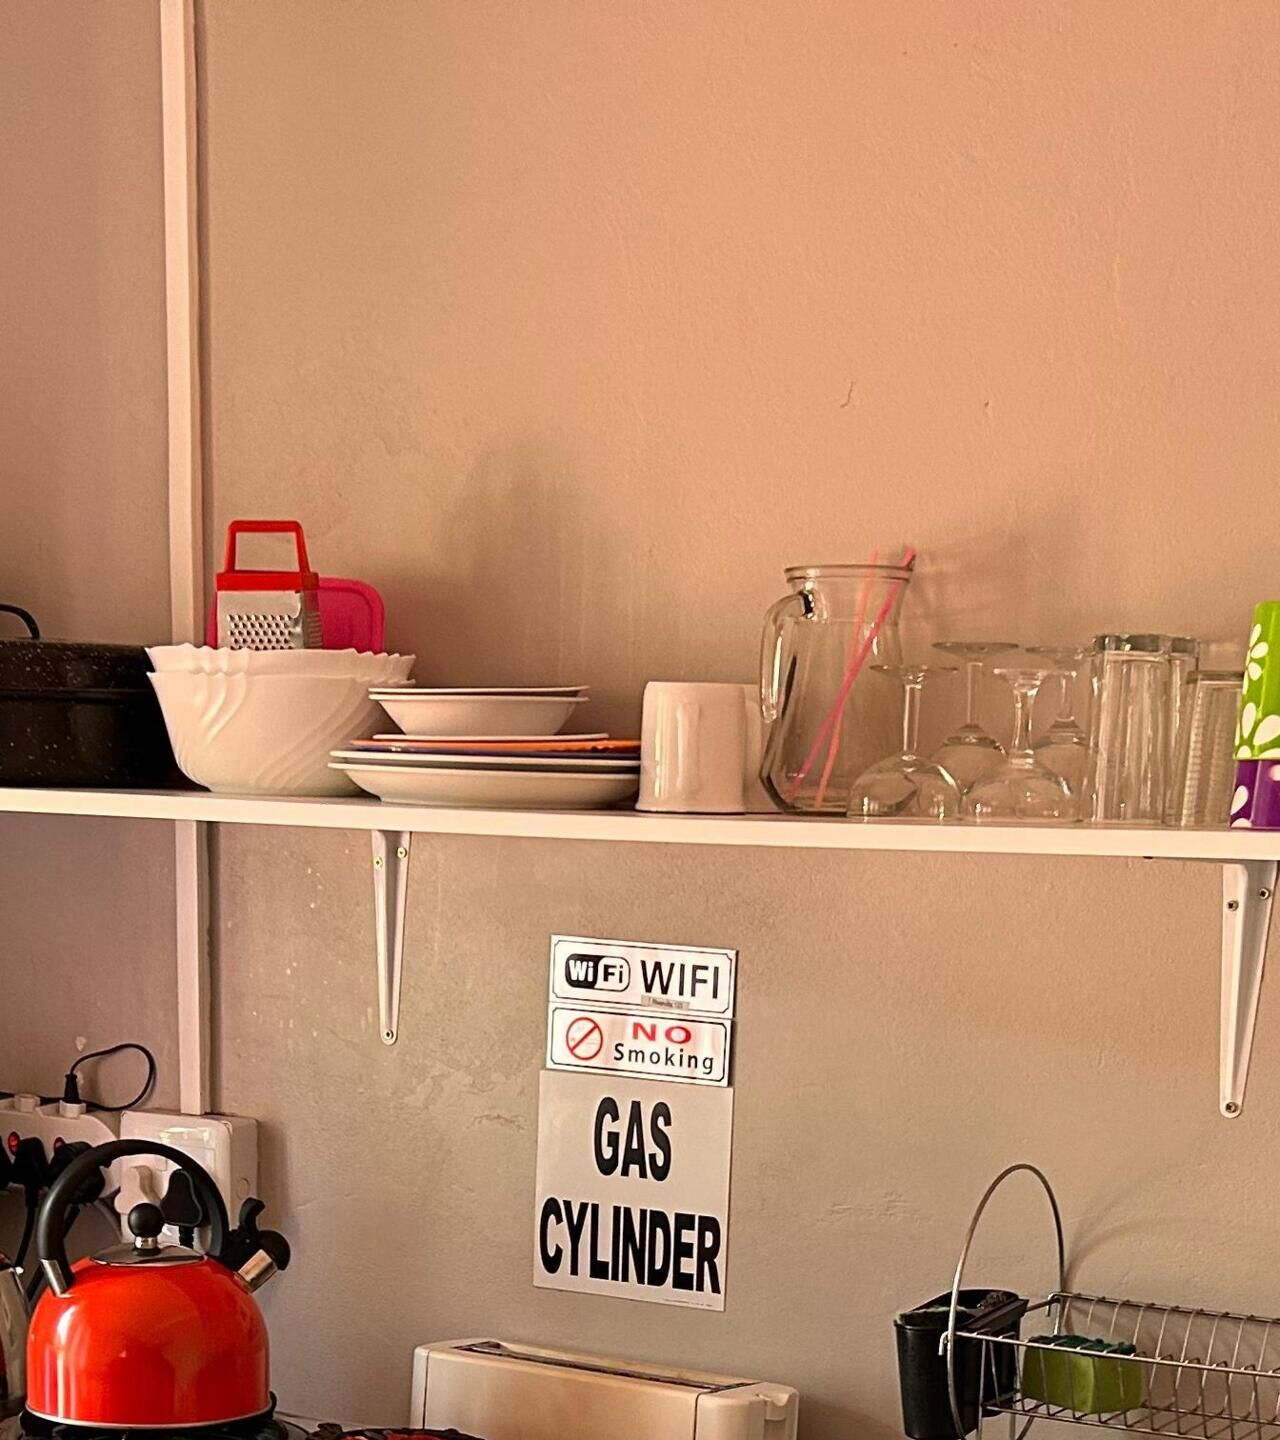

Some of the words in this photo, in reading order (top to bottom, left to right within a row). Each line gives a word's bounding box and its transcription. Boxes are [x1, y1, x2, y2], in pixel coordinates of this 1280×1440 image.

[640, 959, 719, 999] WIFI
[632, 1022, 692, 1045] NO
[613, 1042, 715, 1075] Smoking
[594, 1096, 672, 1182] GAS
[539, 1196, 721, 1295] CYLINDER
